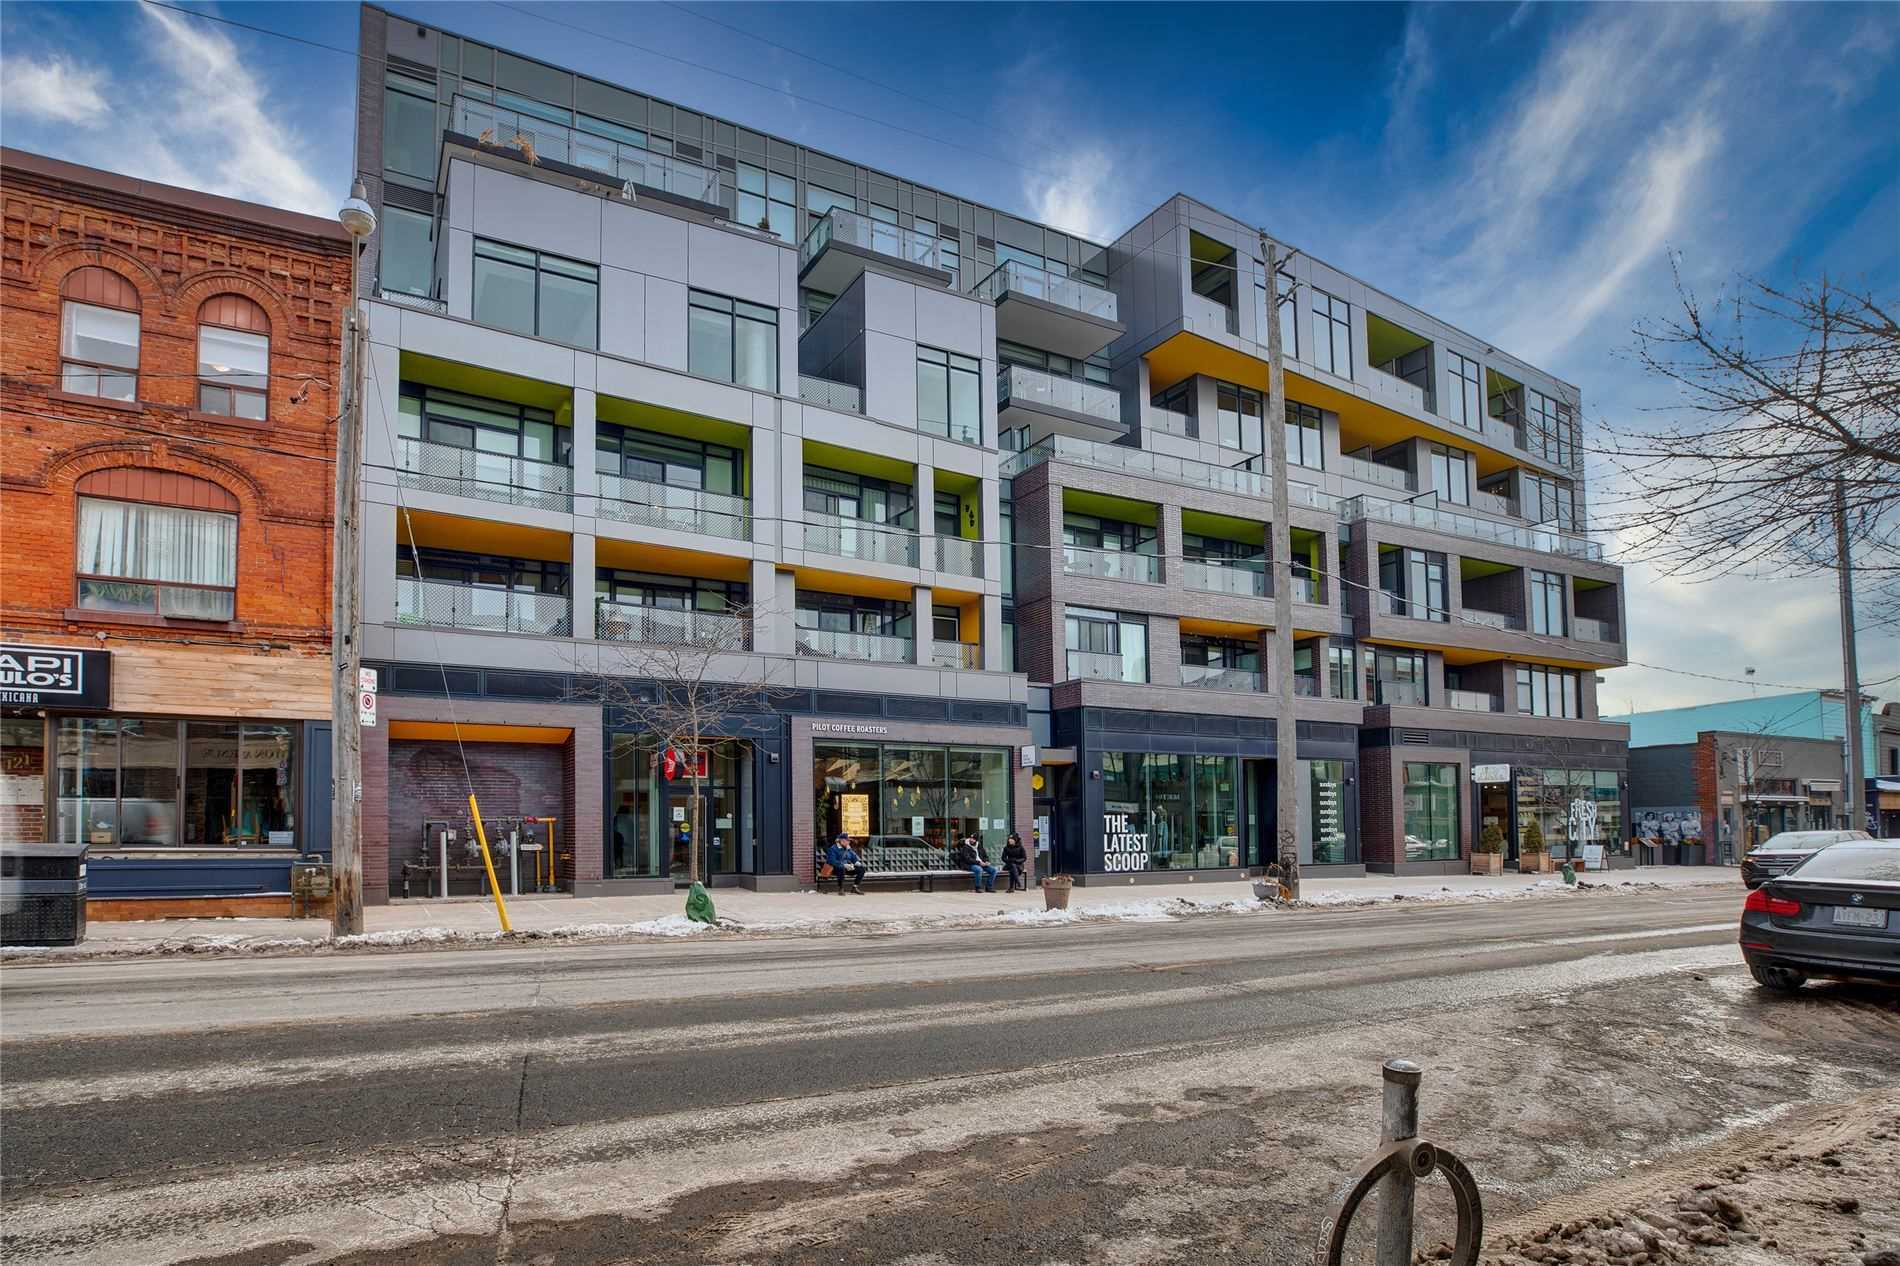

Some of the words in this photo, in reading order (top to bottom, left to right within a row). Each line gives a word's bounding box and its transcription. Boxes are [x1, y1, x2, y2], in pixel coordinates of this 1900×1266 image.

[0, 691, 39, 703] XICANA
[812, 722, 830, 731] PILOT
[831, 724, 856, 733] COFFEE
[856, 725, 888, 734] ROASTERS
[1571, 798, 1597, 817] FRESH
[1103, 814, 1129, 833] THE
[1103, 834, 1149, 852] LATEST
[1103, 853, 1149, 872] SCOOP
